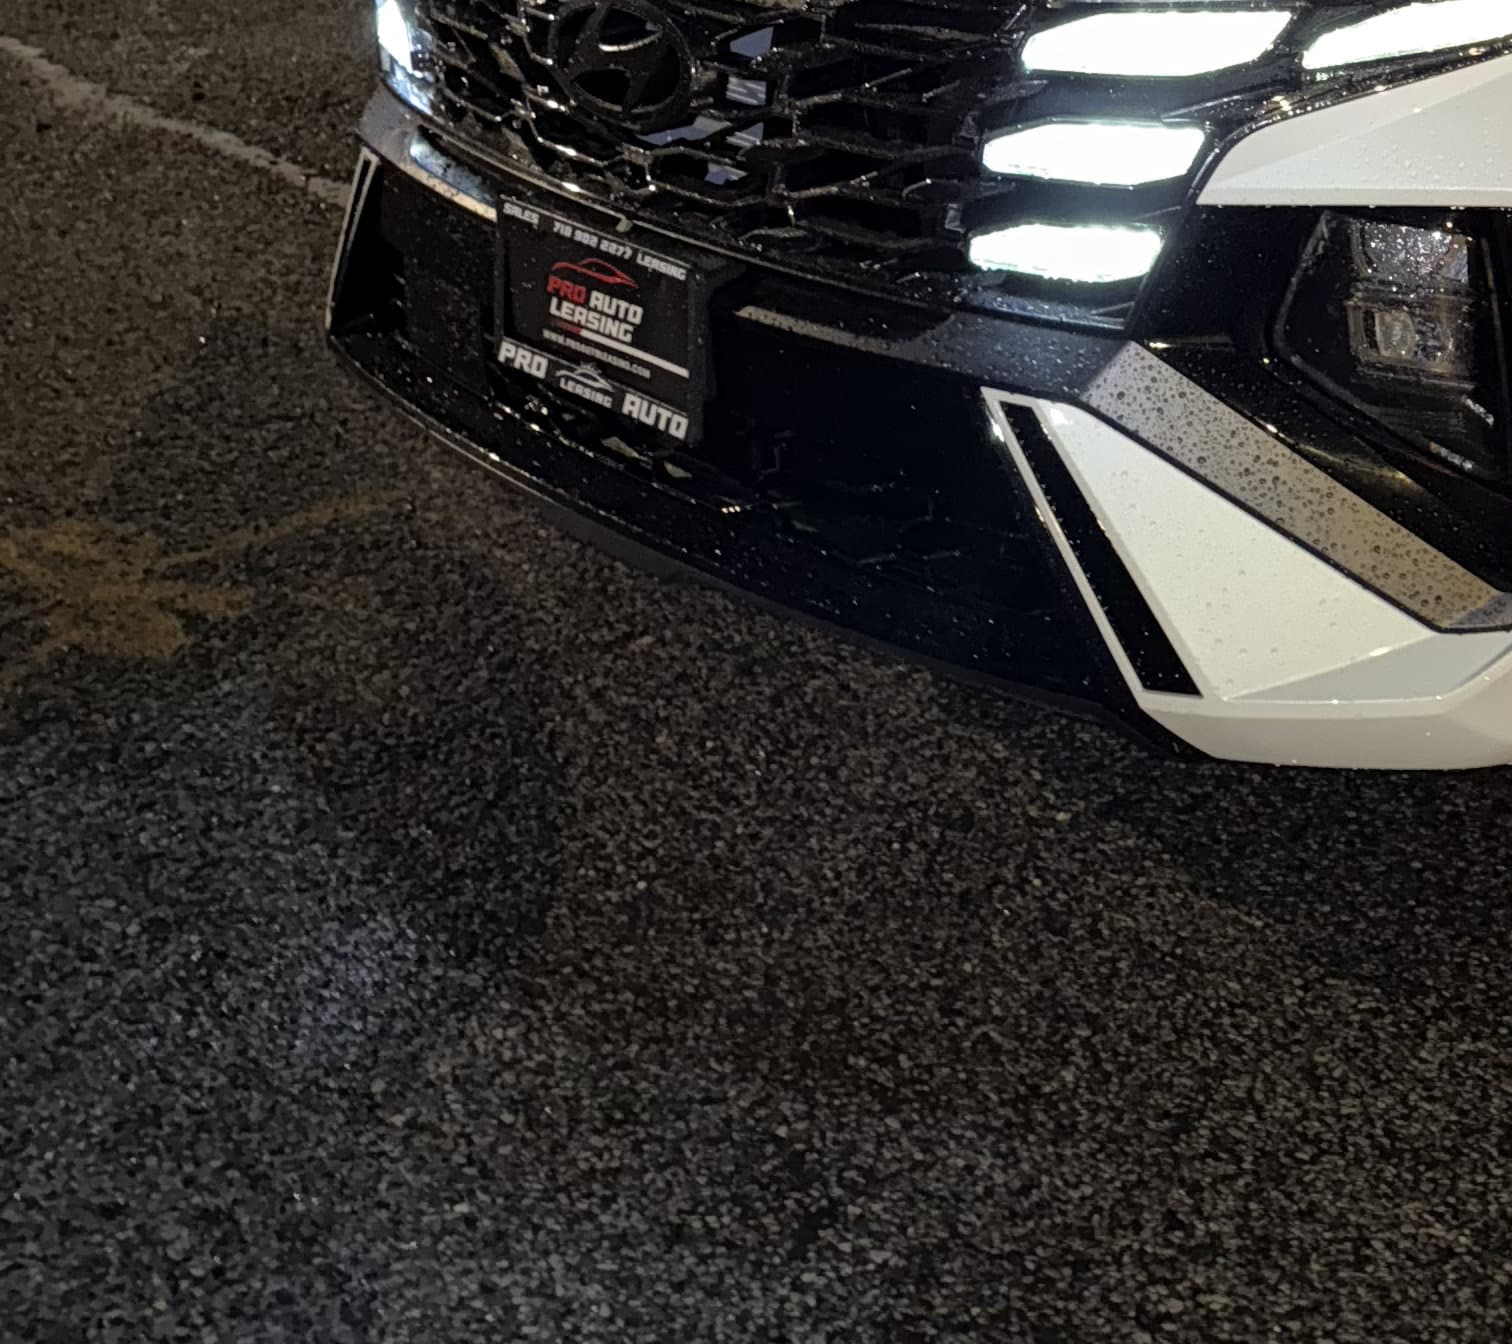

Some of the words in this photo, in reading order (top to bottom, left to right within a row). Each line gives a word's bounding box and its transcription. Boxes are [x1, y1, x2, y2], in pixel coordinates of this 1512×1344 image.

[503, 201, 540, 225] SALES
[553, 221, 571, 238] 718
[574, 231, 598, 248] 902
[599, 240, 633, 260] 2277
[636, 252, 687, 281] LEASING
[546, 275, 586, 304] PRO
[589, 290, 643, 325] AUTO
[549, 296, 634, 343] LEASING
[498, 341, 549, 379] PRO
[560, 377, 613, 409] LEASING
[622, 393, 689, 441] AUTO
